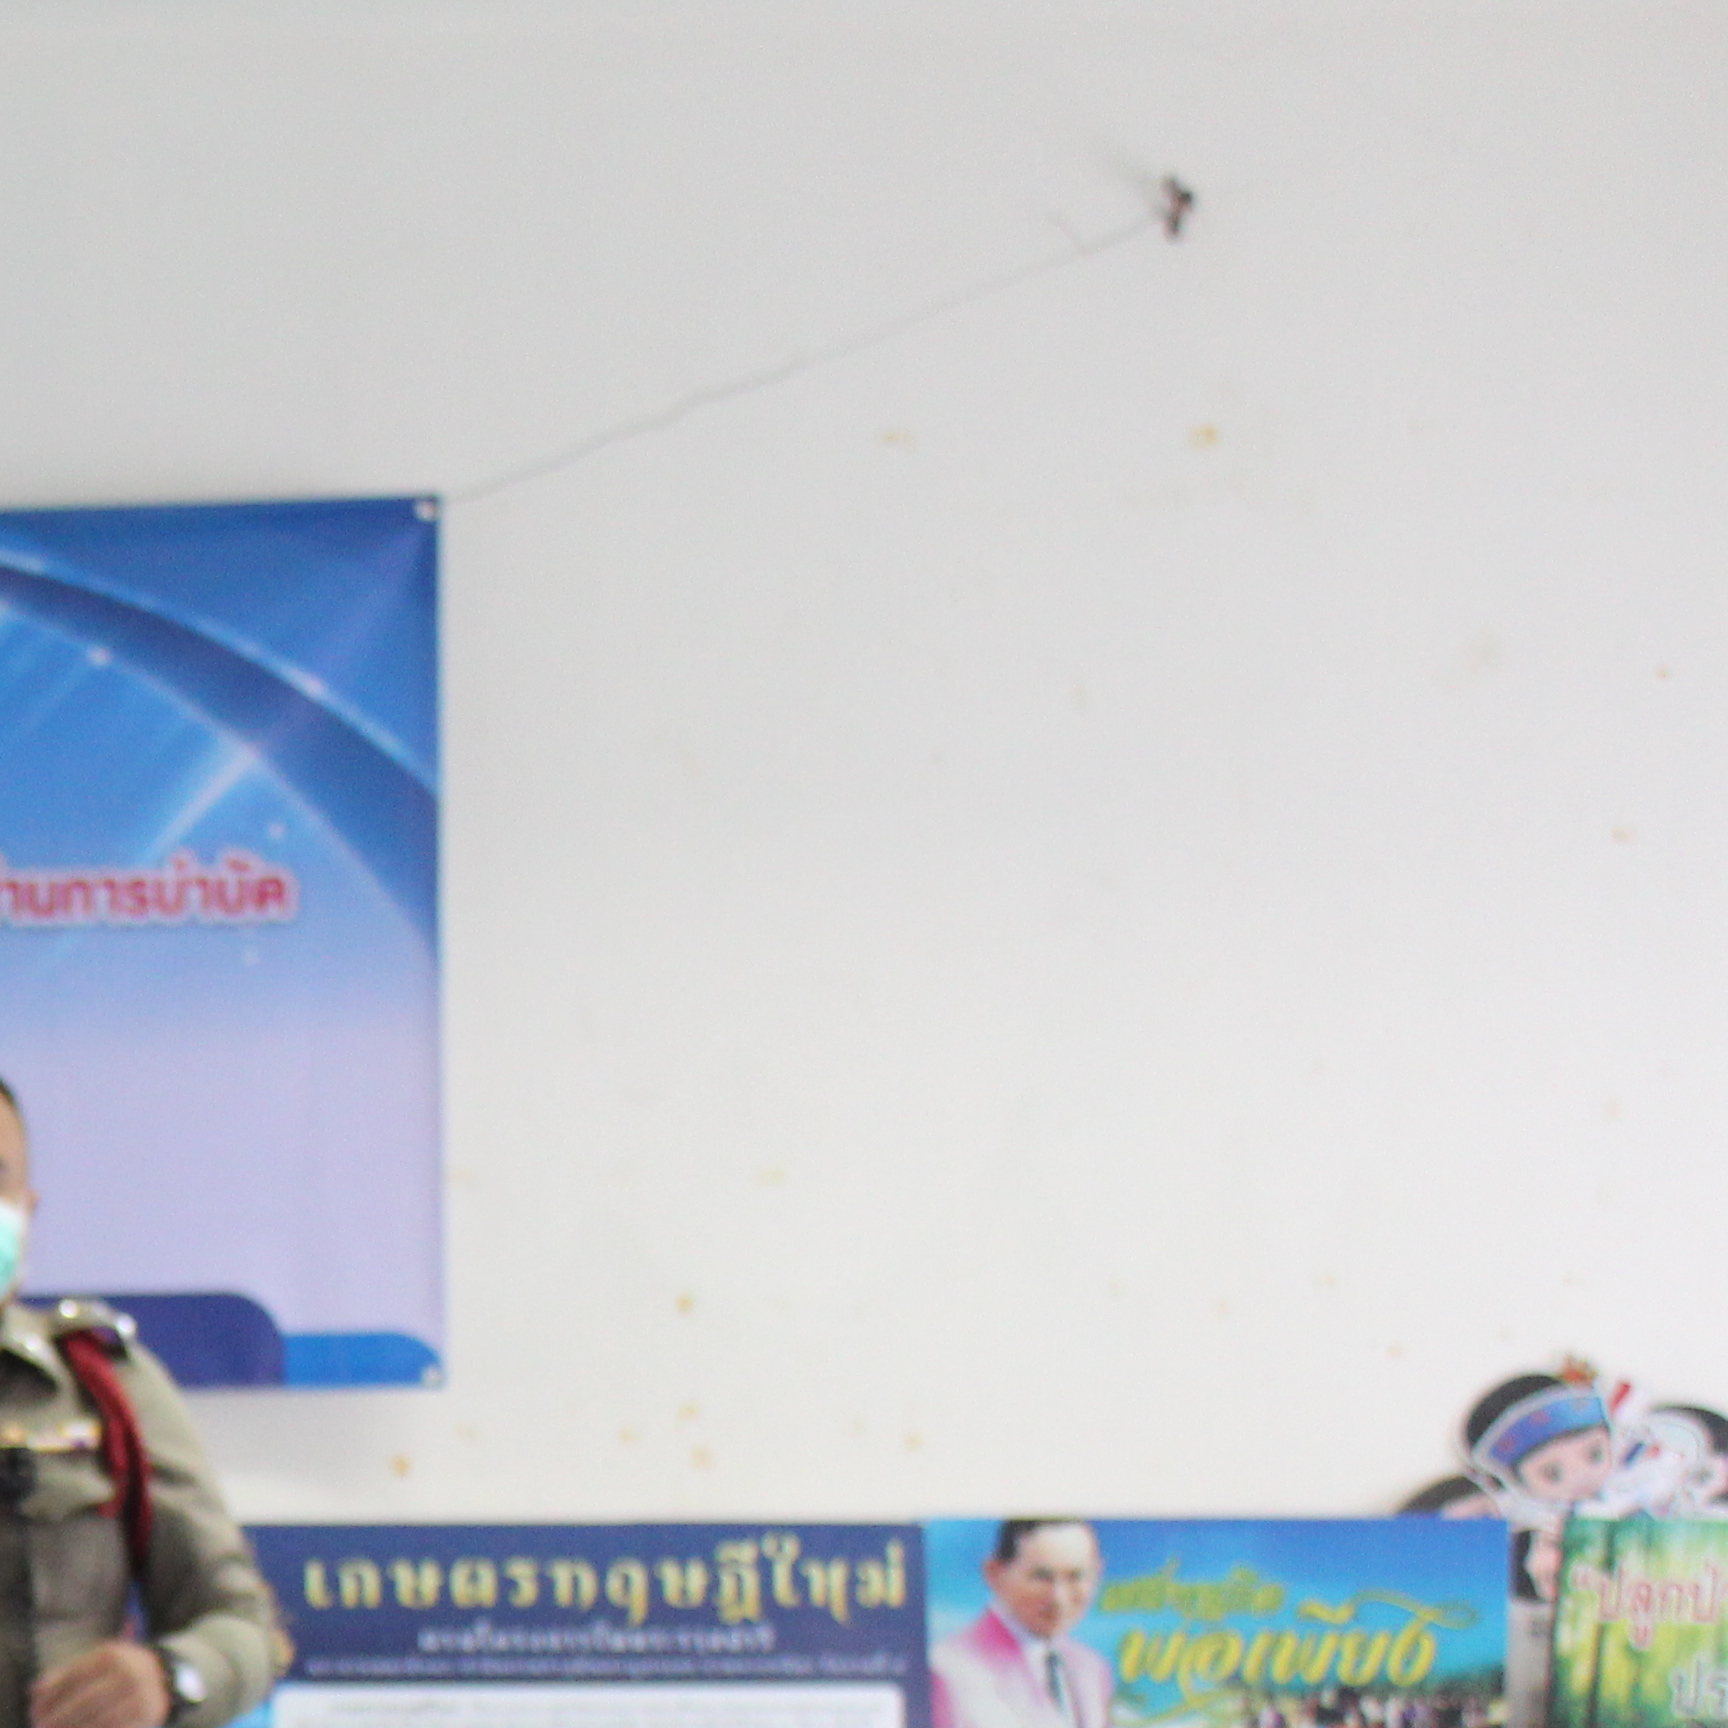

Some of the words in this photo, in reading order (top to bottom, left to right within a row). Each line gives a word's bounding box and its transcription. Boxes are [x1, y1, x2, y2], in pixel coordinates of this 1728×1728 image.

[303, 1533, 909, 1626] เกษตรทฤษฎีใหม่
[1666, 1650, 1728, 1720] ปร
